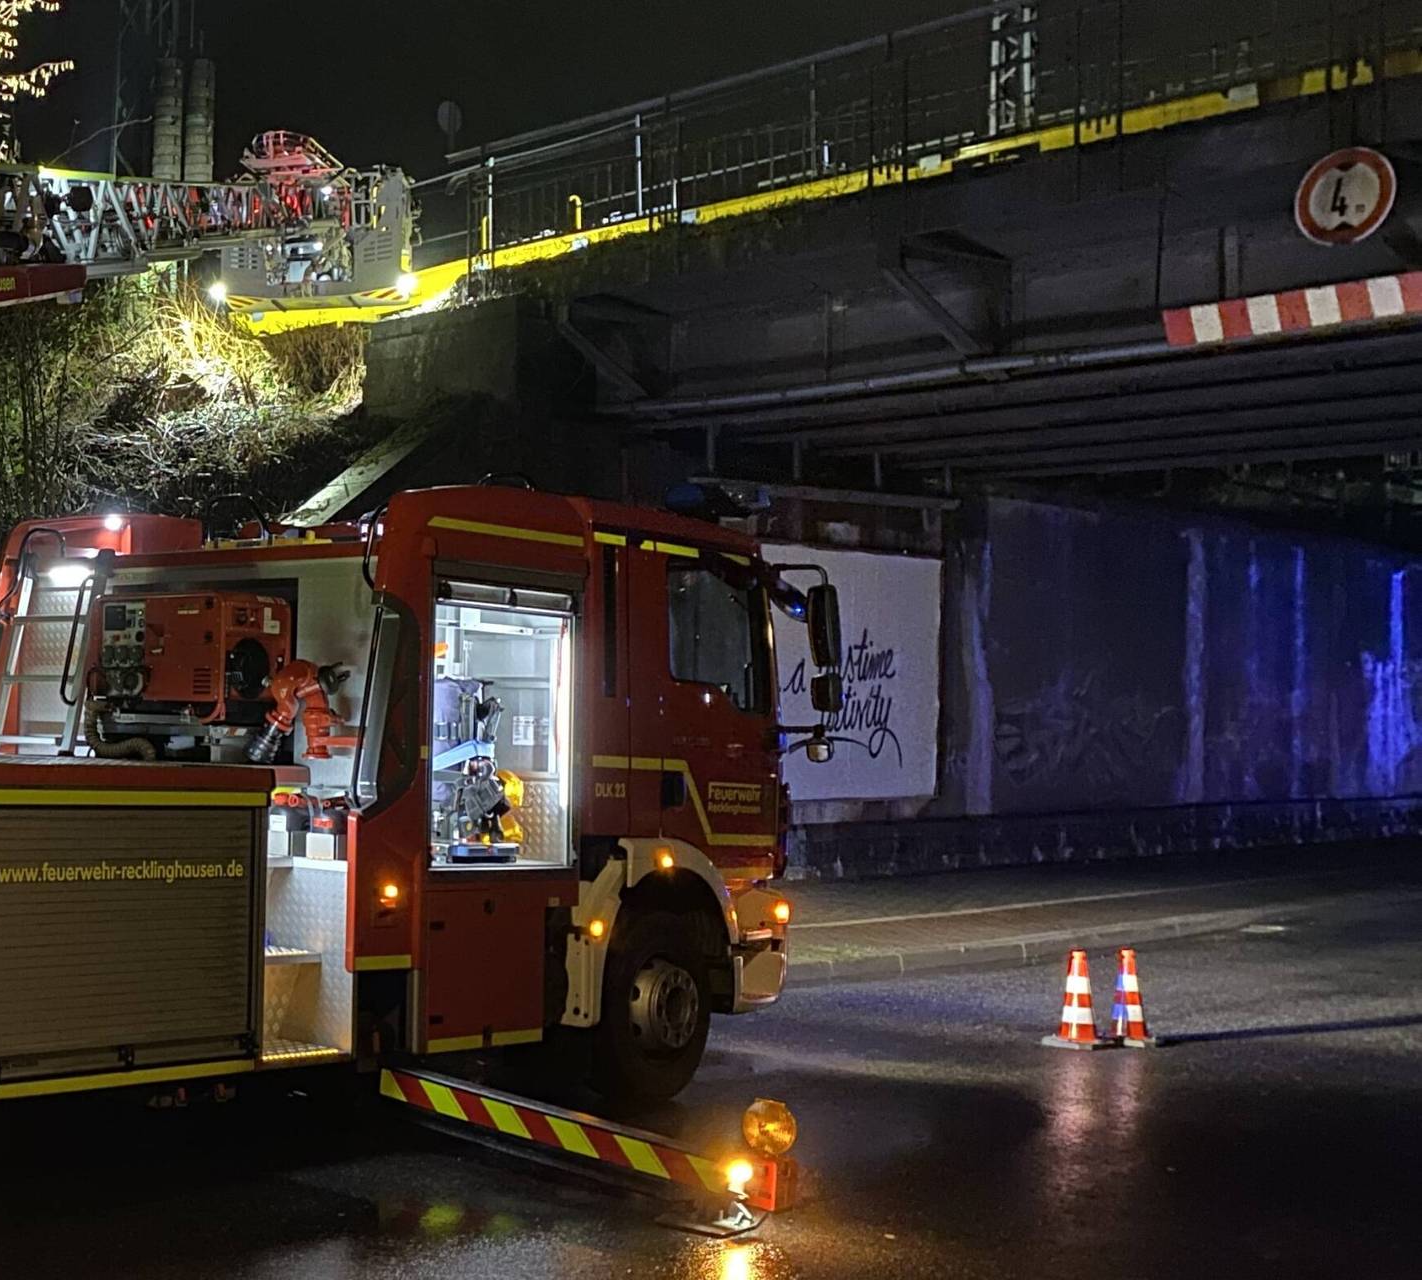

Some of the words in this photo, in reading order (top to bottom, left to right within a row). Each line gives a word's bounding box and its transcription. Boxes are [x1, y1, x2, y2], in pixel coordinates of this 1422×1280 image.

[1330, 177, 1348, 217] 4
[819, 628, 896, 683] stime
[595, 782, 613, 798] DLK
[615, 783, 626, 798] 23
[708, 781, 762, 800] Feuerwehr
